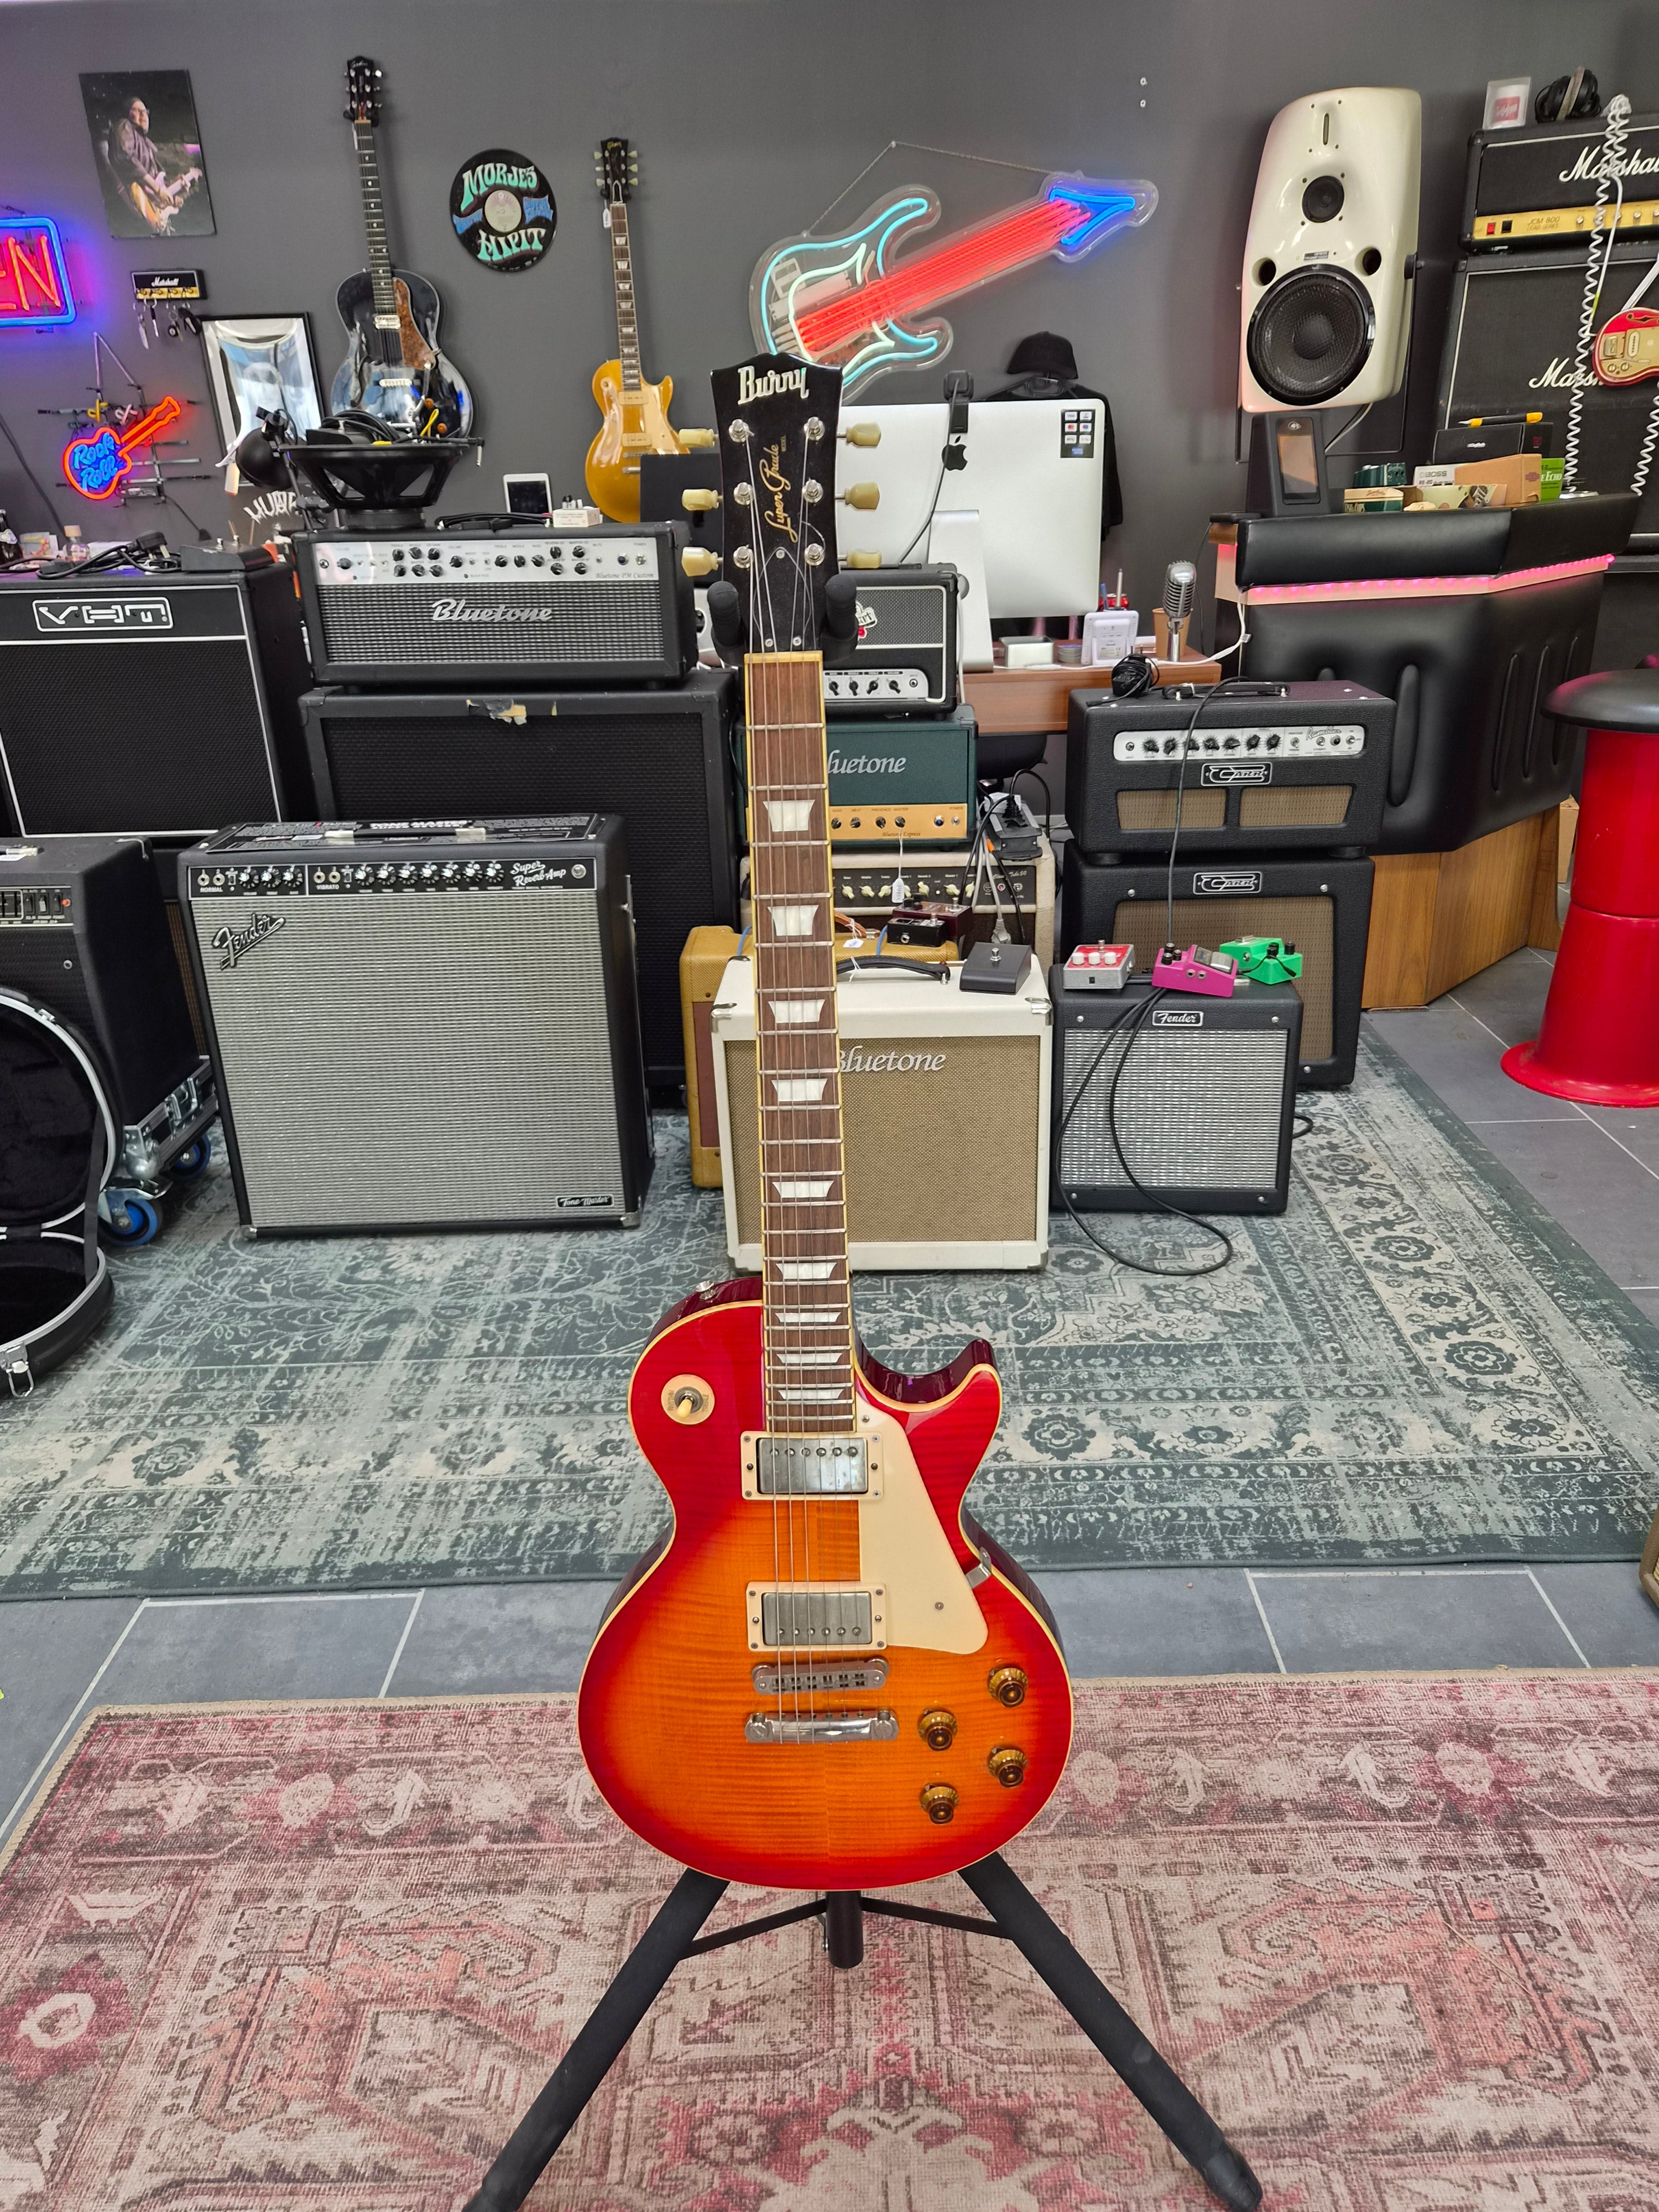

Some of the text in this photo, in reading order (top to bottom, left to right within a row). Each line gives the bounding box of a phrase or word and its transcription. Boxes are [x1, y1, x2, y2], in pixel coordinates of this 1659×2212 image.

[461, 163, 538, 212] MORJES
[1527, 217, 1544, 226] JCM
[477, 227, 546, 262] HIPIT
[738, 365, 809, 405] Burny
[1528, 357, 1603, 388] Mars
[74, 432, 114, 469] Rock
[80, 455, 118, 491] Roll
[1425, 470, 1448, 478] BOSS
[432, 599, 552, 621] Bluetone
[827, 749, 907, 774] luetone
[510, 860, 546, 875] Super
[213, 912, 284, 969] Fender
[1157, 1013, 1197, 1024] Fender
[559, 1196, 608, 1207] Tone Master
